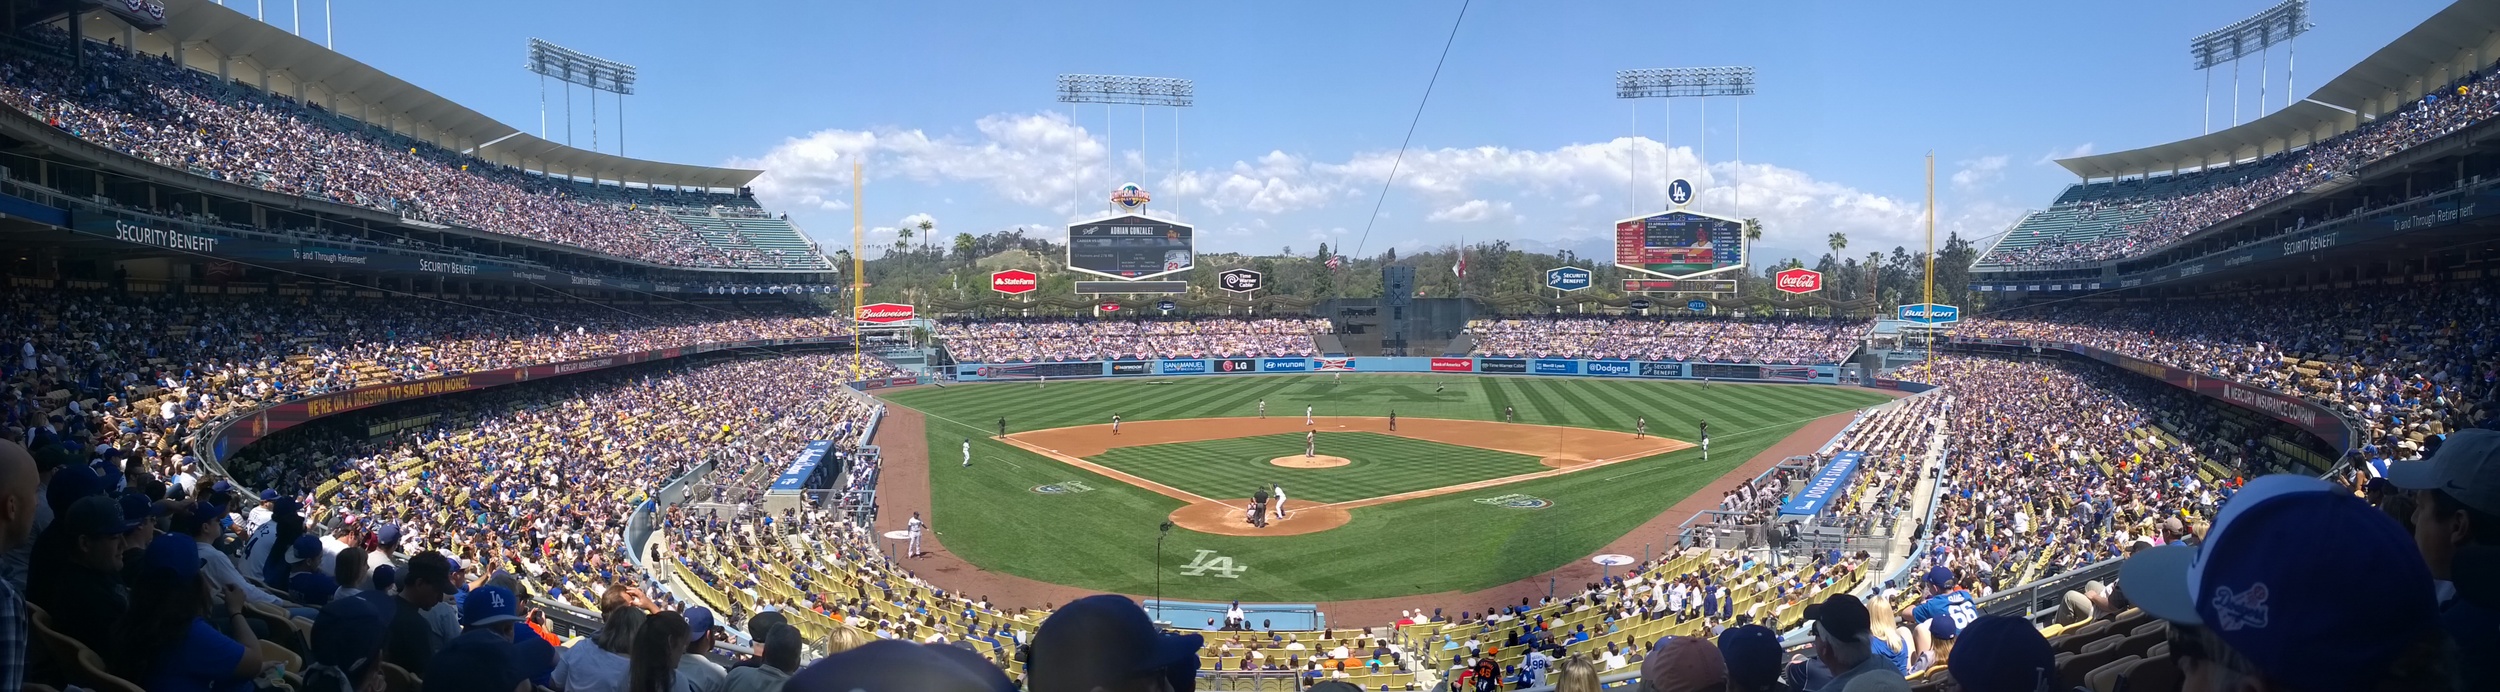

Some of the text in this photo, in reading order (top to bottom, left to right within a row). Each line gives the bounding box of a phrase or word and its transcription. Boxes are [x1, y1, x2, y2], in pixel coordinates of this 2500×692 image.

[1672, 182, 1686, 201] LA
[2393, 219, 2400, 232] To
[2400, 217, 2412, 230] and
[2412, 212, 2436, 228] Through
[115, 219, 168, 247] SECURITY
[1110, 227, 1154, 235] ADRIAN GONZALEZ
[2283, 238, 2309, 256] SECURITY
[292, 248, 300, 259] To
[302, 251, 314, 261] and
[314, 251, 337, 264] Through
[419, 258, 451, 274] SECURITY
[1780, 274, 1816, 288] Coca-Cola
[858, 309, 912, 320] Budweiser
[560, 358, 613, 372] MERCURY INSURANCE COMPANY
[1235, 362, 1247, 370] LG
[1589, 364, 1628, 373] @Dodgers
[307, 399, 332, 417] WE'RE
[333, 398, 345, 411] ON
[346, 397, 353, 409] A
[354, 387, 388, 407] MISSION
[390, 386, 401, 399] TO
[403, 382, 425, 398] SAVE
[426, 380, 443, 395] YOU
[2230, 387, 2317, 428] MERCURY INSURANCE COMPANY
[1180, 549, 1248, 579] LA
[490, 591, 505, 608] LA
[2214, 589, 2266, 626] Dodgers
[1948, 601, 1978, 630] 66
[1532, 660, 1544, 670] 98
